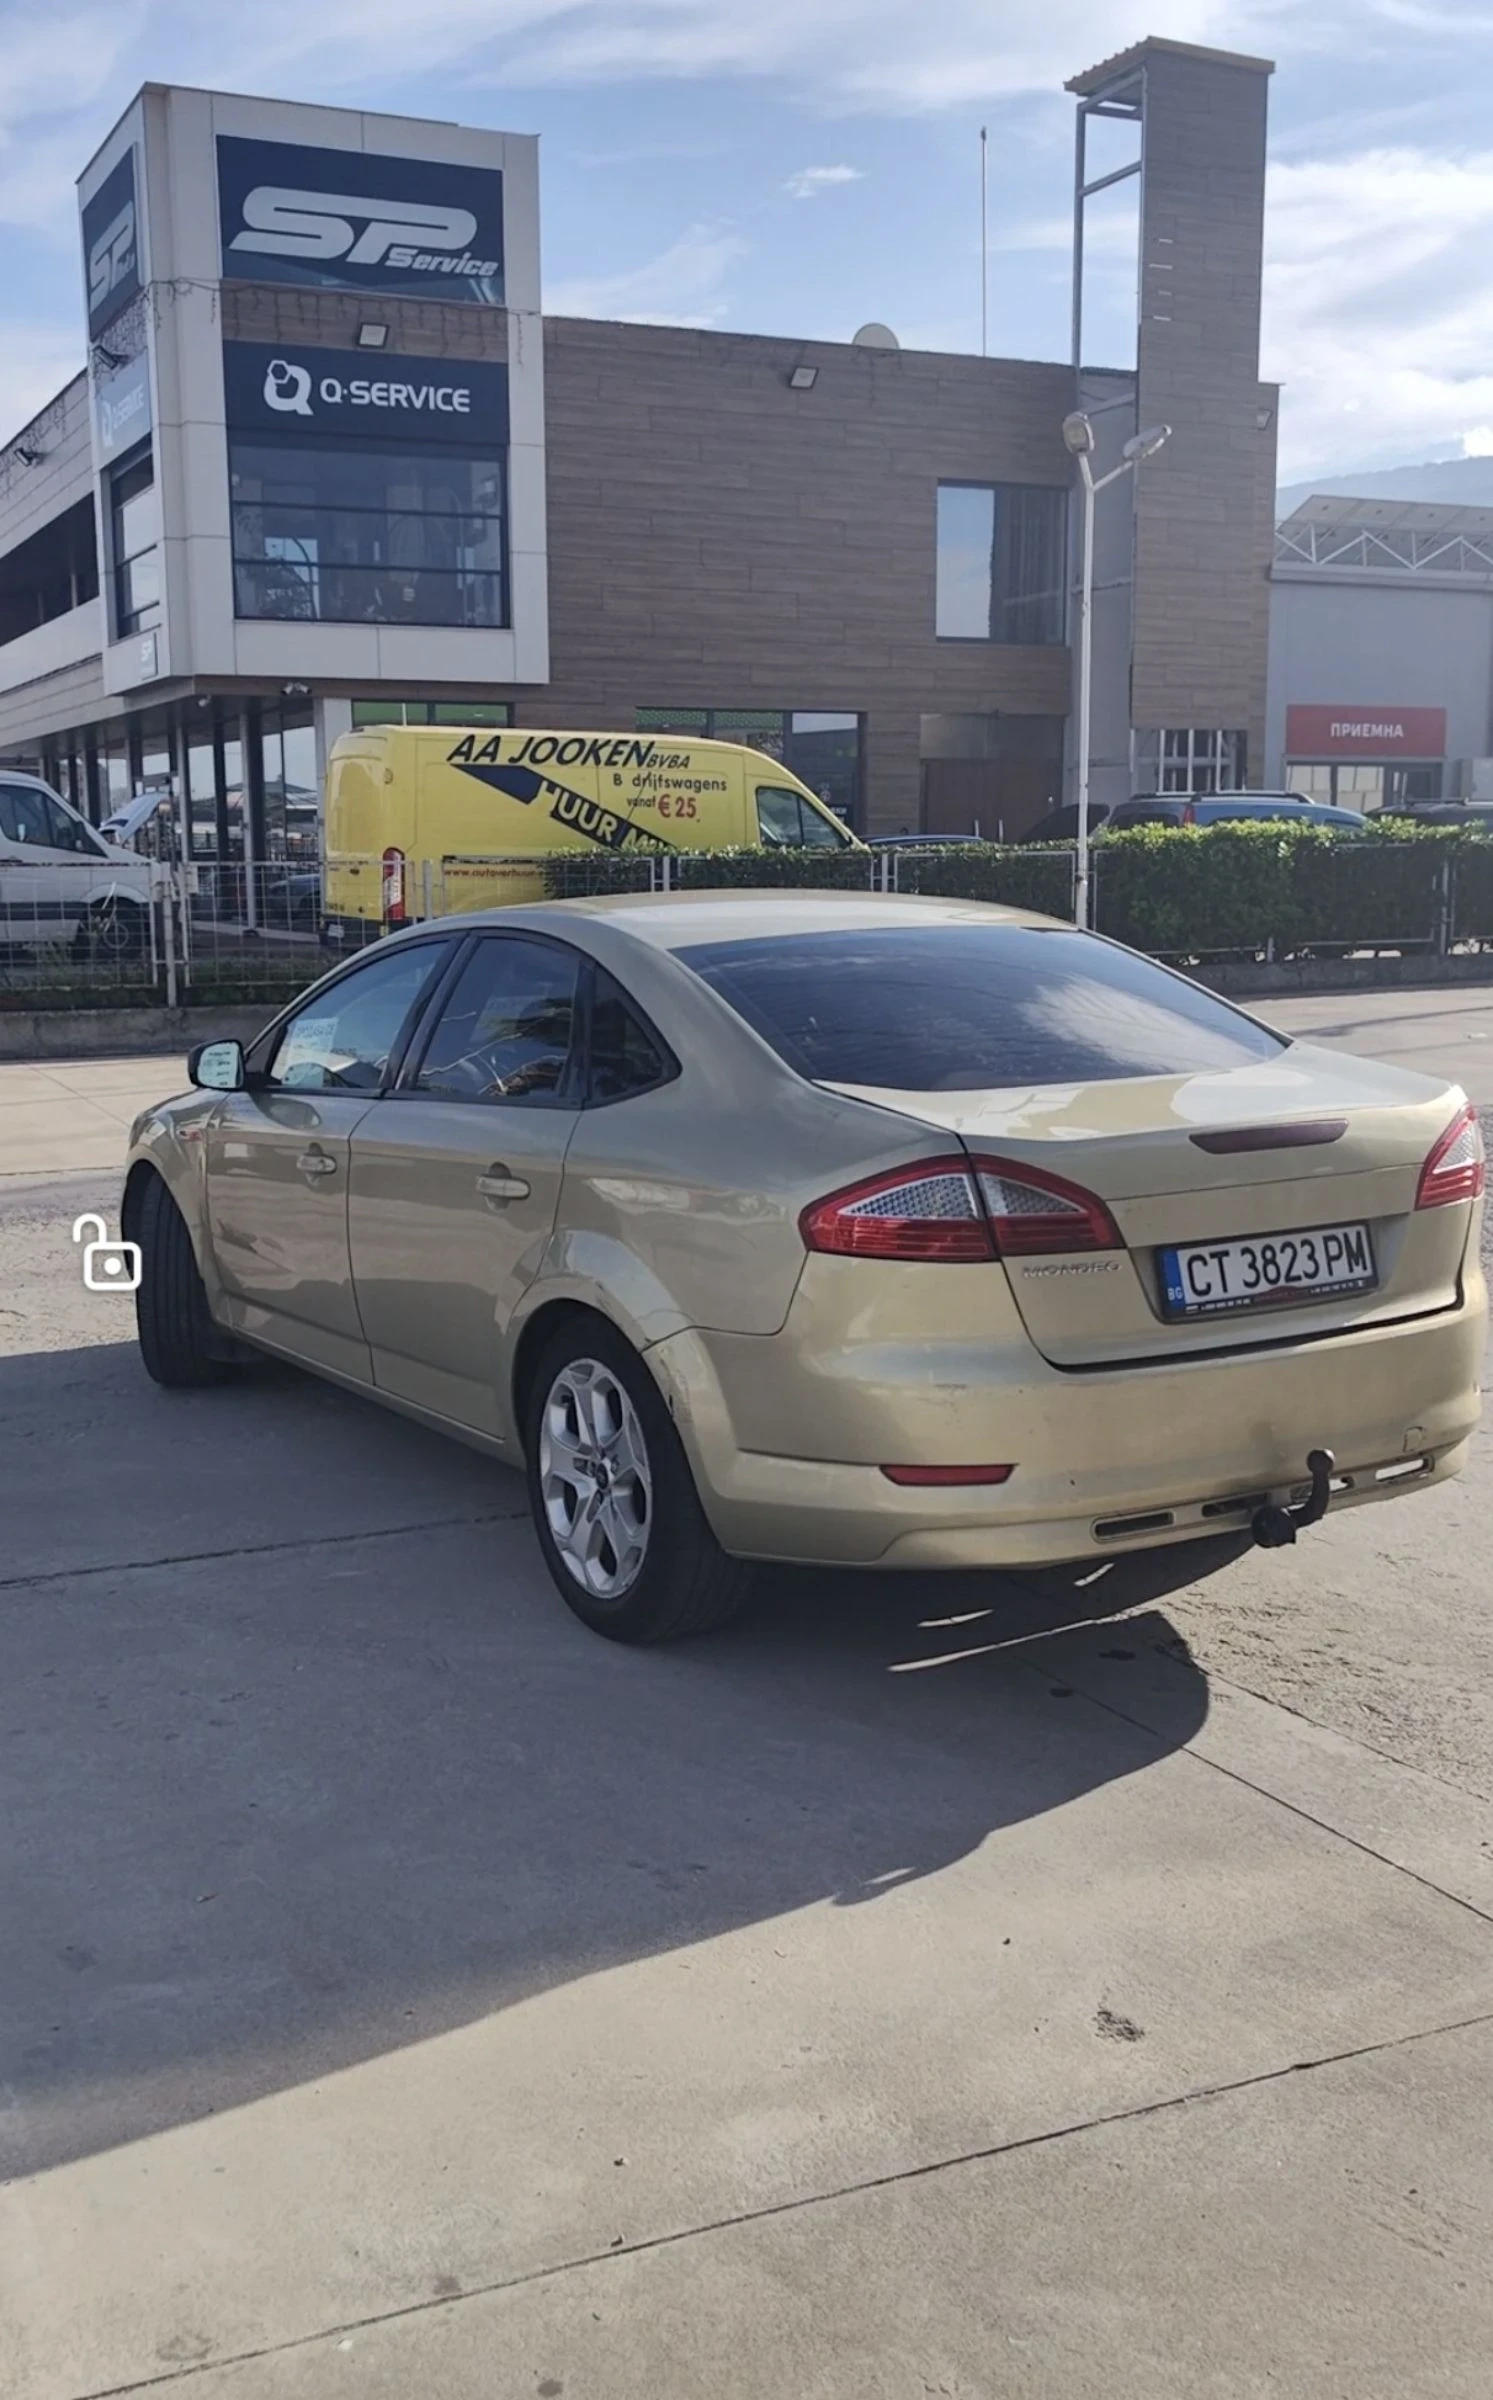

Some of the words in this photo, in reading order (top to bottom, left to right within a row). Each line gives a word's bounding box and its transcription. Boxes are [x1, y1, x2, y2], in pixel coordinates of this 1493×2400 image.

[228, 185, 478, 264] SP
[384, 247, 499, 277] Service
[1330, 722, 1405, 738] ПРИЕМНА
[446, 734, 501, 763] AA
[508, 735, 656, 768] JOOKEN
[646, 754, 691, 769] BVBA
[1022, 1260, 1122, 1279] MONDEO
[1186, 1250, 1229, 1297] CT
[1240, 1238, 1320, 1289] 3823
[1322, 1230, 1368, 1277] PM
[1167, 1286, 1185, 1302] BG
